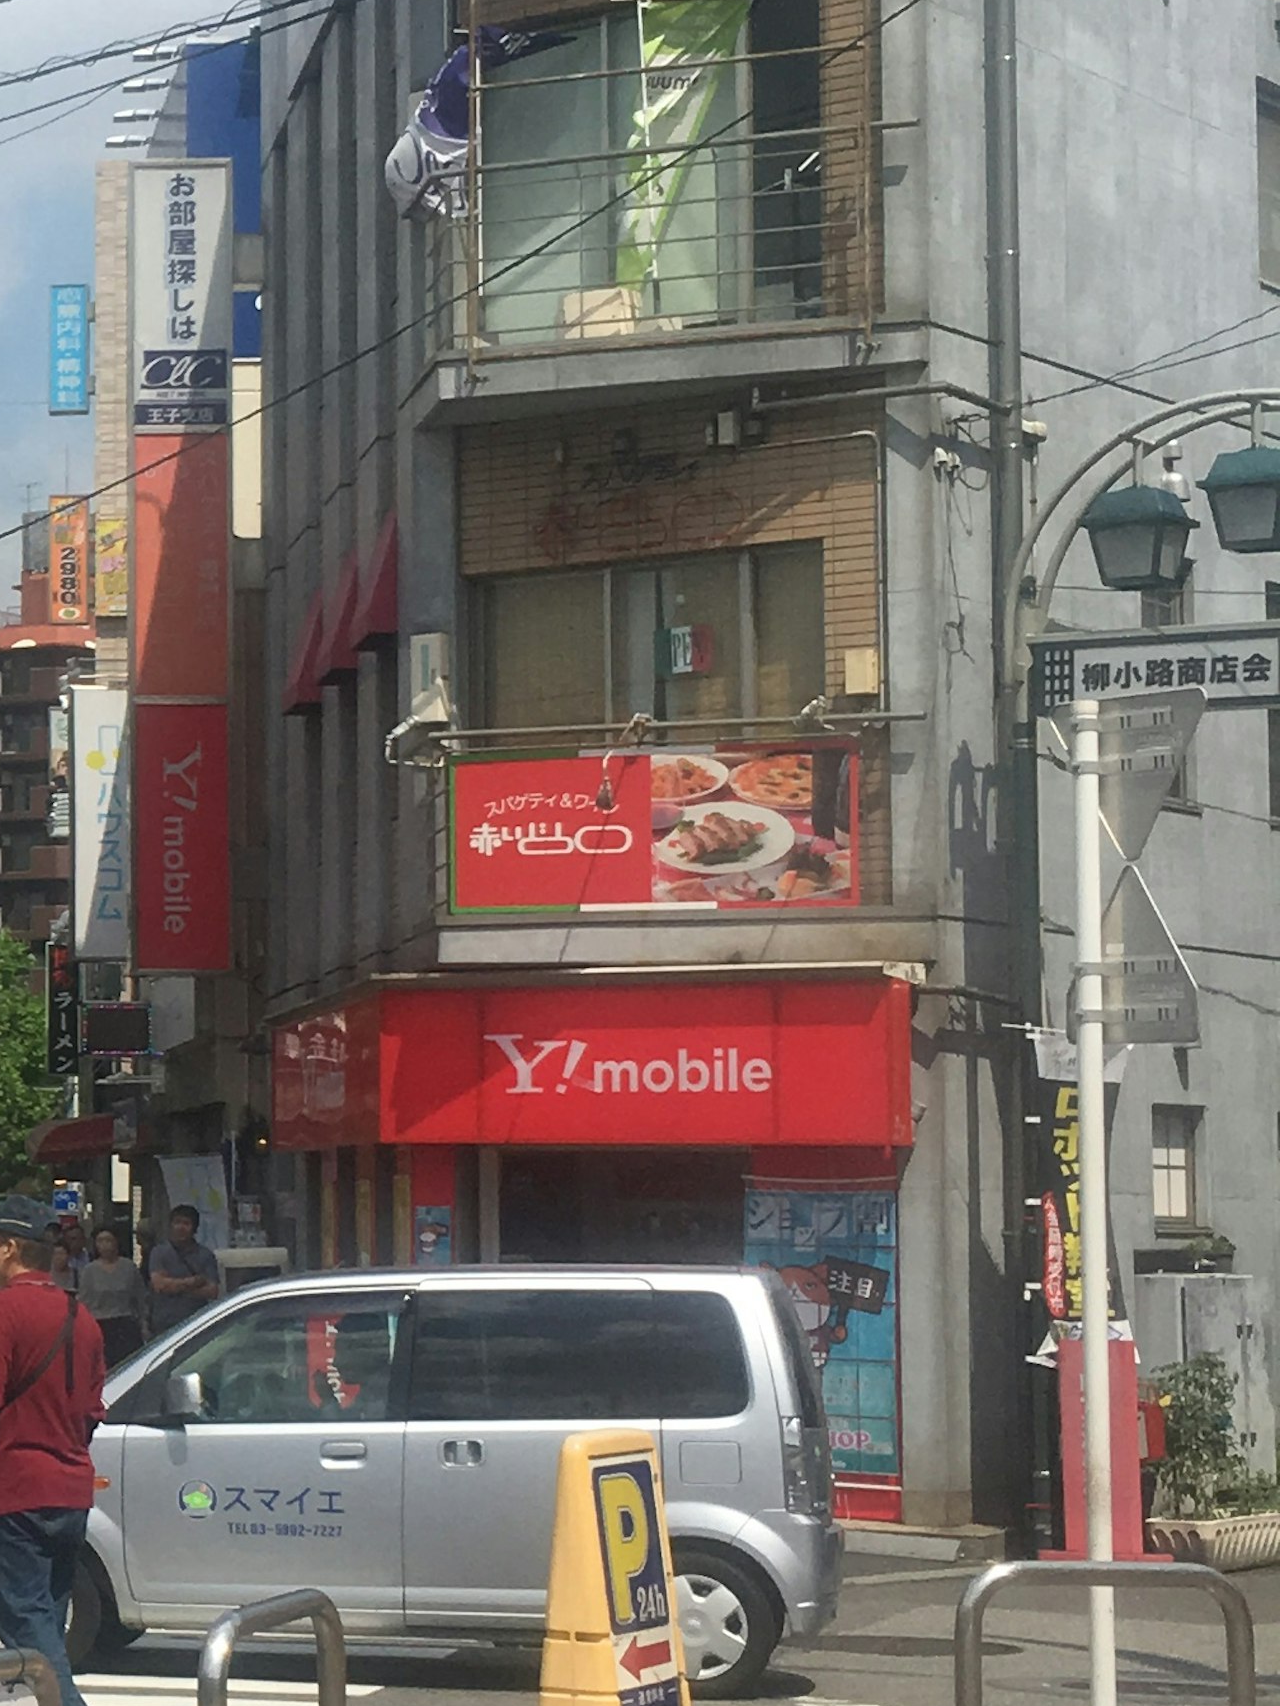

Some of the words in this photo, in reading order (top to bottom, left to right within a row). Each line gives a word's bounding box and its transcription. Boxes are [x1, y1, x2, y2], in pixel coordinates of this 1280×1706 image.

[168, 173, 196, 341] お部屋探しは
[1081, 652, 1274, 691] 柳小路商店会
[162, 741, 203, 935] Y!mobile
[54, 991, 73, 1072] ラーメン
[484, 1032, 772, 1095] Y!mobile
[829, 1270, 874, 1299] 注目
[223, 1487, 345, 1515] スマイエ
[227, 1522, 249, 1535] TEL
[599, 1472, 649, 1626] P
[636, 1583, 667, 1622] 24h
